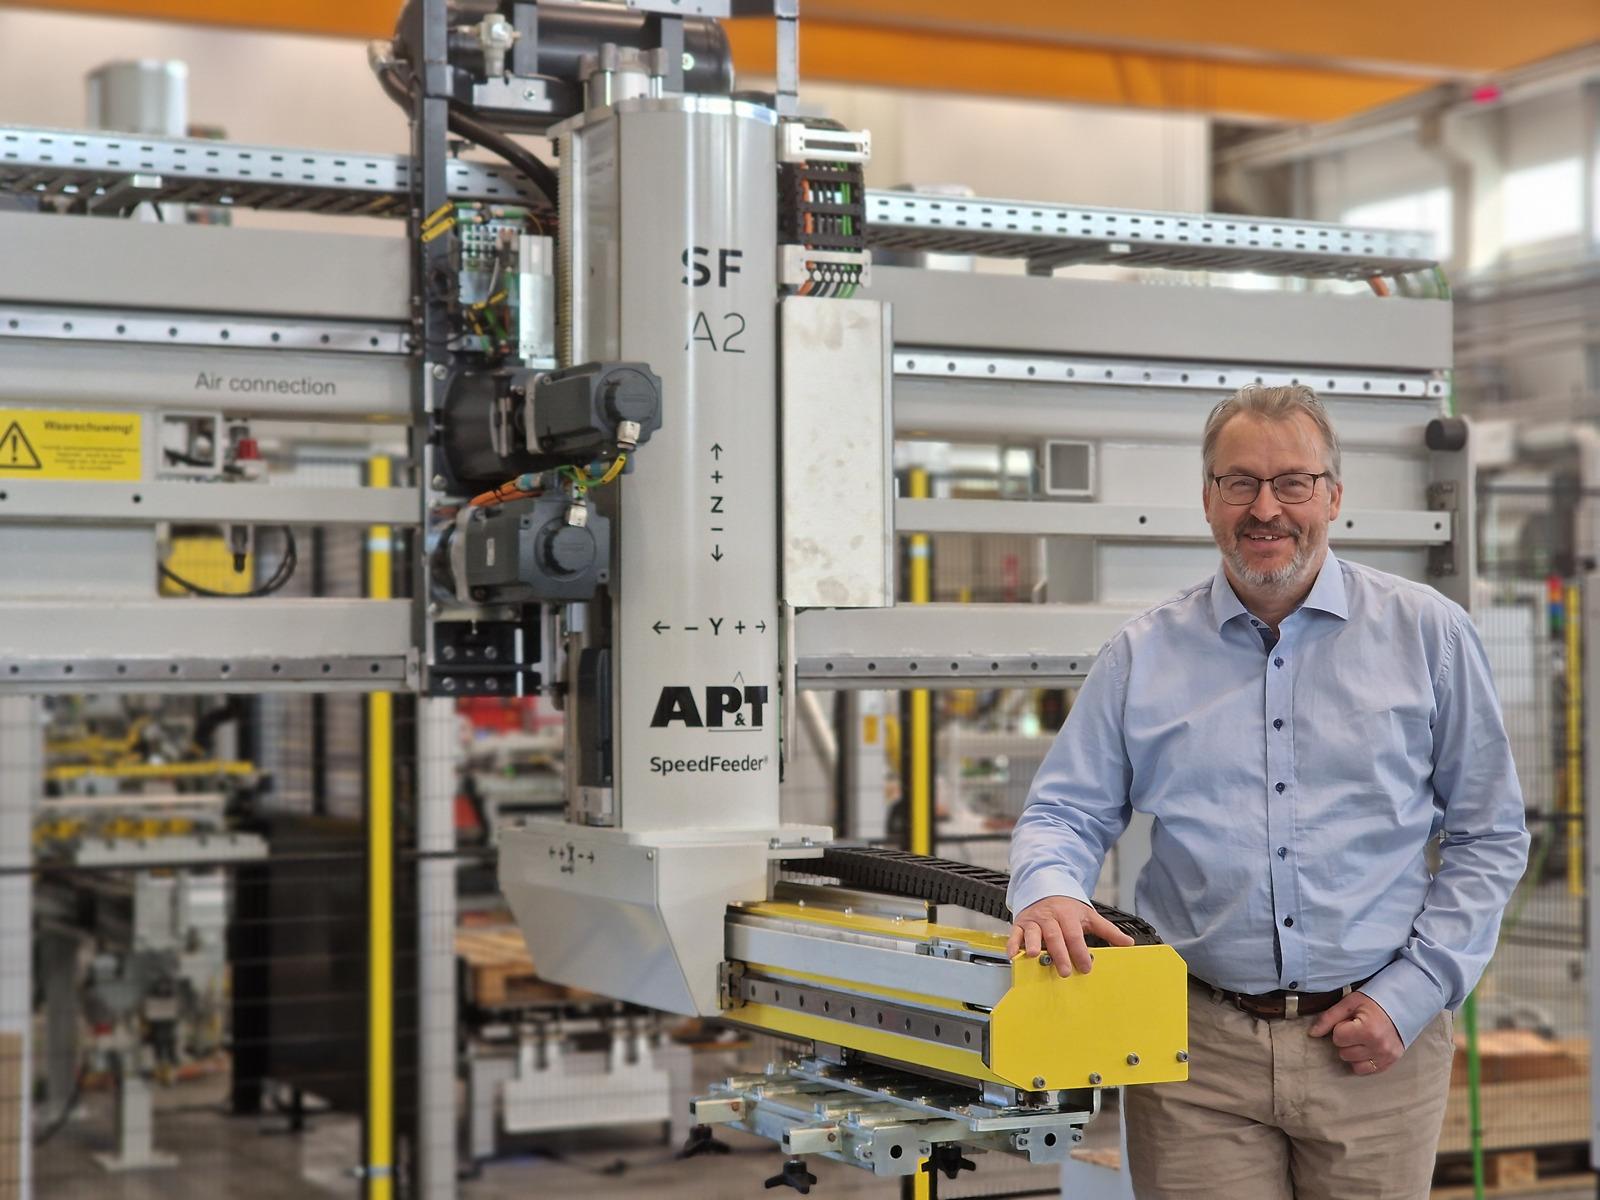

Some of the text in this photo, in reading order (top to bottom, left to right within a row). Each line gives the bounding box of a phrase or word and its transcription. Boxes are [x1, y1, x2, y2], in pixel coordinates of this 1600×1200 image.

[681, 246, 743, 288] SF
[684, 311, 746, 354] A2
[194, 372, 337, 396] Air connection
[710, 496, 724, 513] Z
[709, 617, 724, 636] Y
